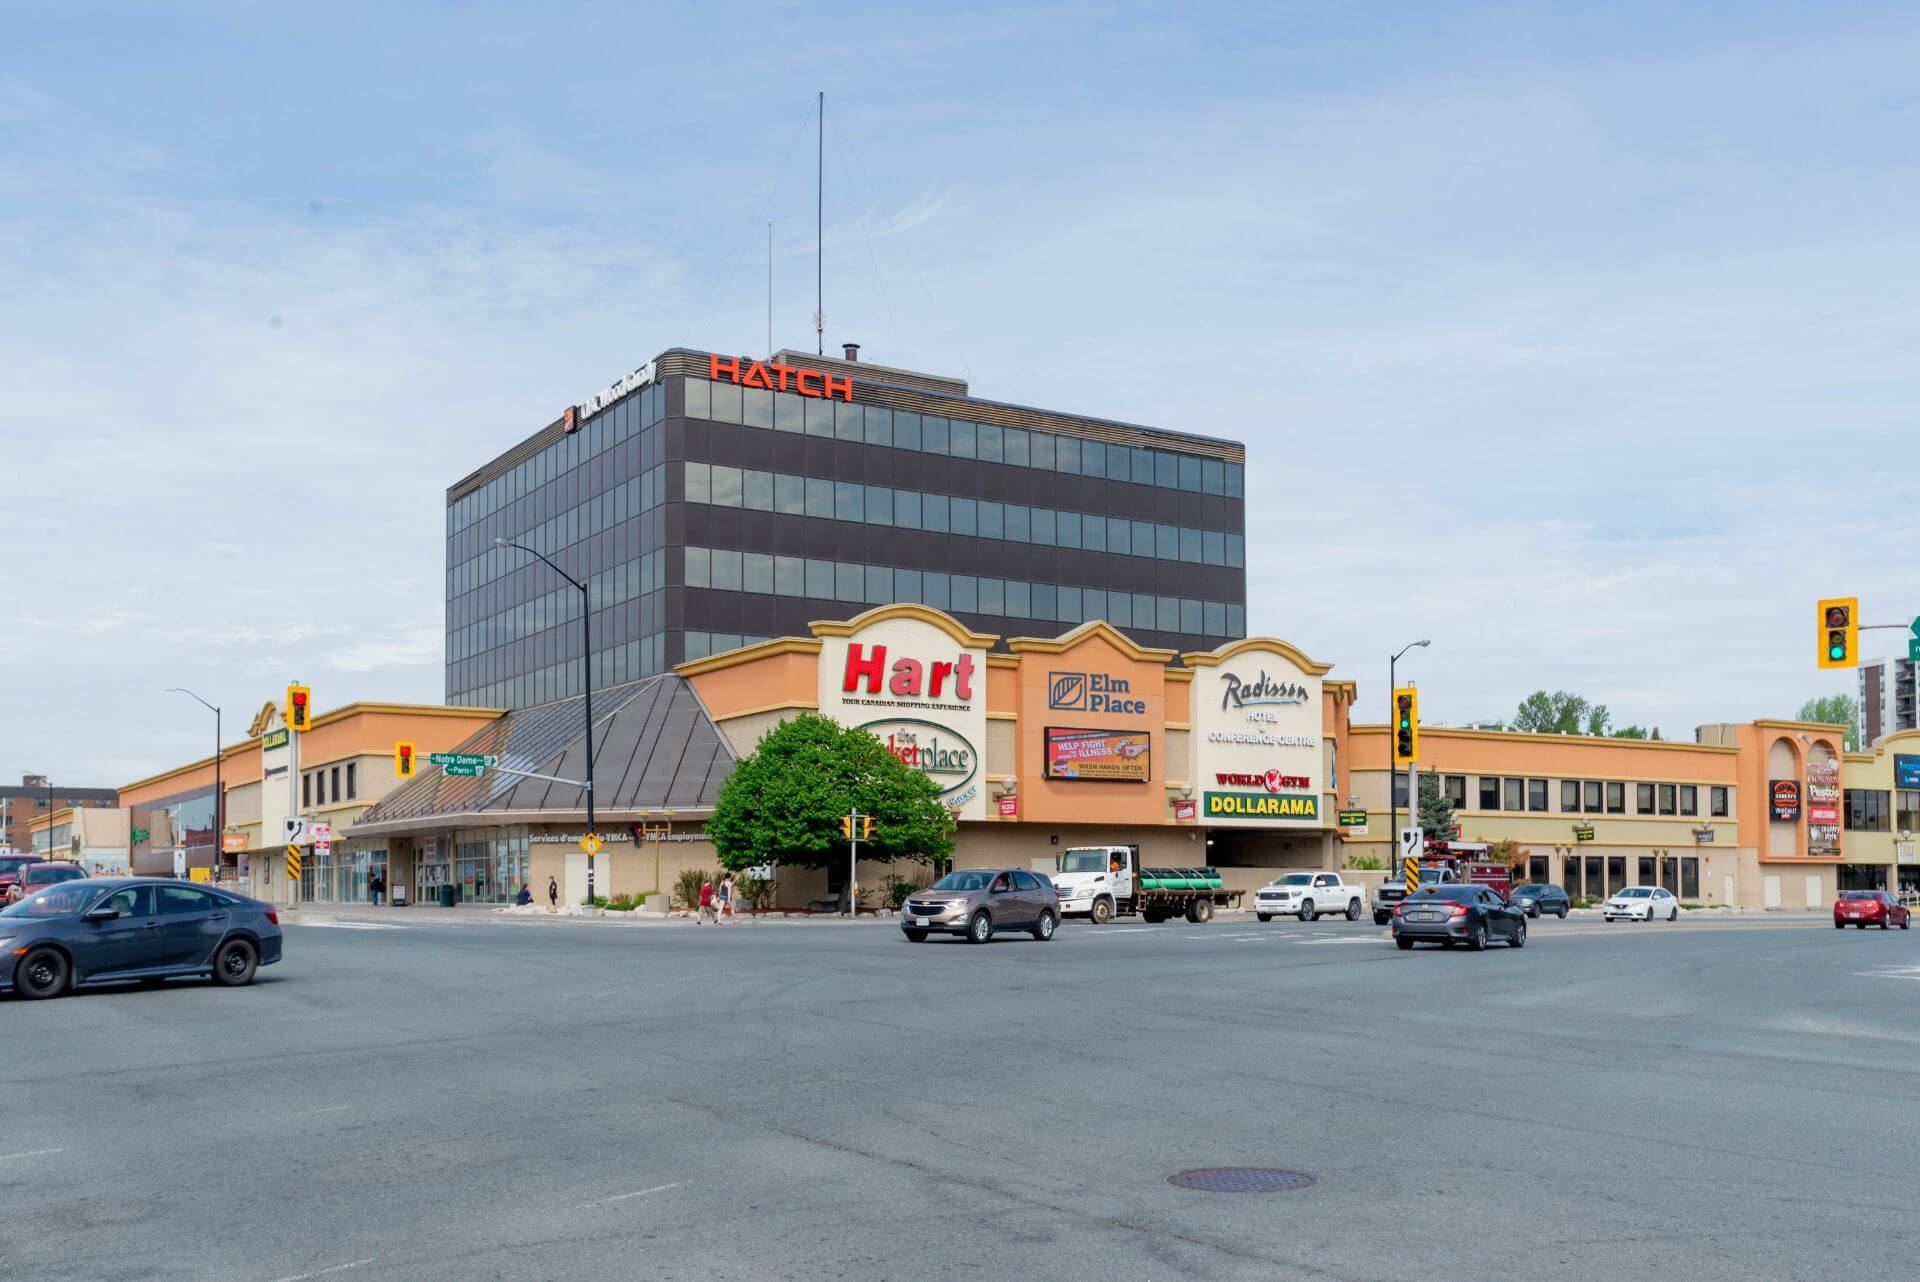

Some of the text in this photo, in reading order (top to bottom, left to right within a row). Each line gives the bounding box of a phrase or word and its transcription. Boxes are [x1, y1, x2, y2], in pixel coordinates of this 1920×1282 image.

[710, 354, 853, 401] HATCH
[843, 643, 975, 700] Hart
[1090, 673, 1130, 694] Elm
[1221, 670, 1309, 711] Radisson
[842, 698, 971, 712] YOUR CANADIAN SHOPPING EXPERIENCE
[1090, 694, 1146, 714] Place
[1246, 711, 1278, 723] HOTEL
[897, 728, 917, 743] the
[1208, 730, 1316, 748] CONFERENCE CENTRE
[1058, 739, 1105, 751] HELP FIGHT
[1079, 747, 1113, 758] ILLNESS
[436, 755, 455, 764] Notre
[457, 755, 477, 764] Dame
[886, 733, 969, 774] ketplace
[1099, 763, 1121, 771] HANDS
[1122, 764, 1143, 772] OFTEN
[1216, 773, 1311, 788] WORLD GYM
[947, 785, 977, 809] Grocer
[1210, 796, 1316, 816] DOLLARAMA
[529, 833, 559, 843] Services
[606, 833, 628, 842] YMCA
[646, 832, 667, 841] YMCA
